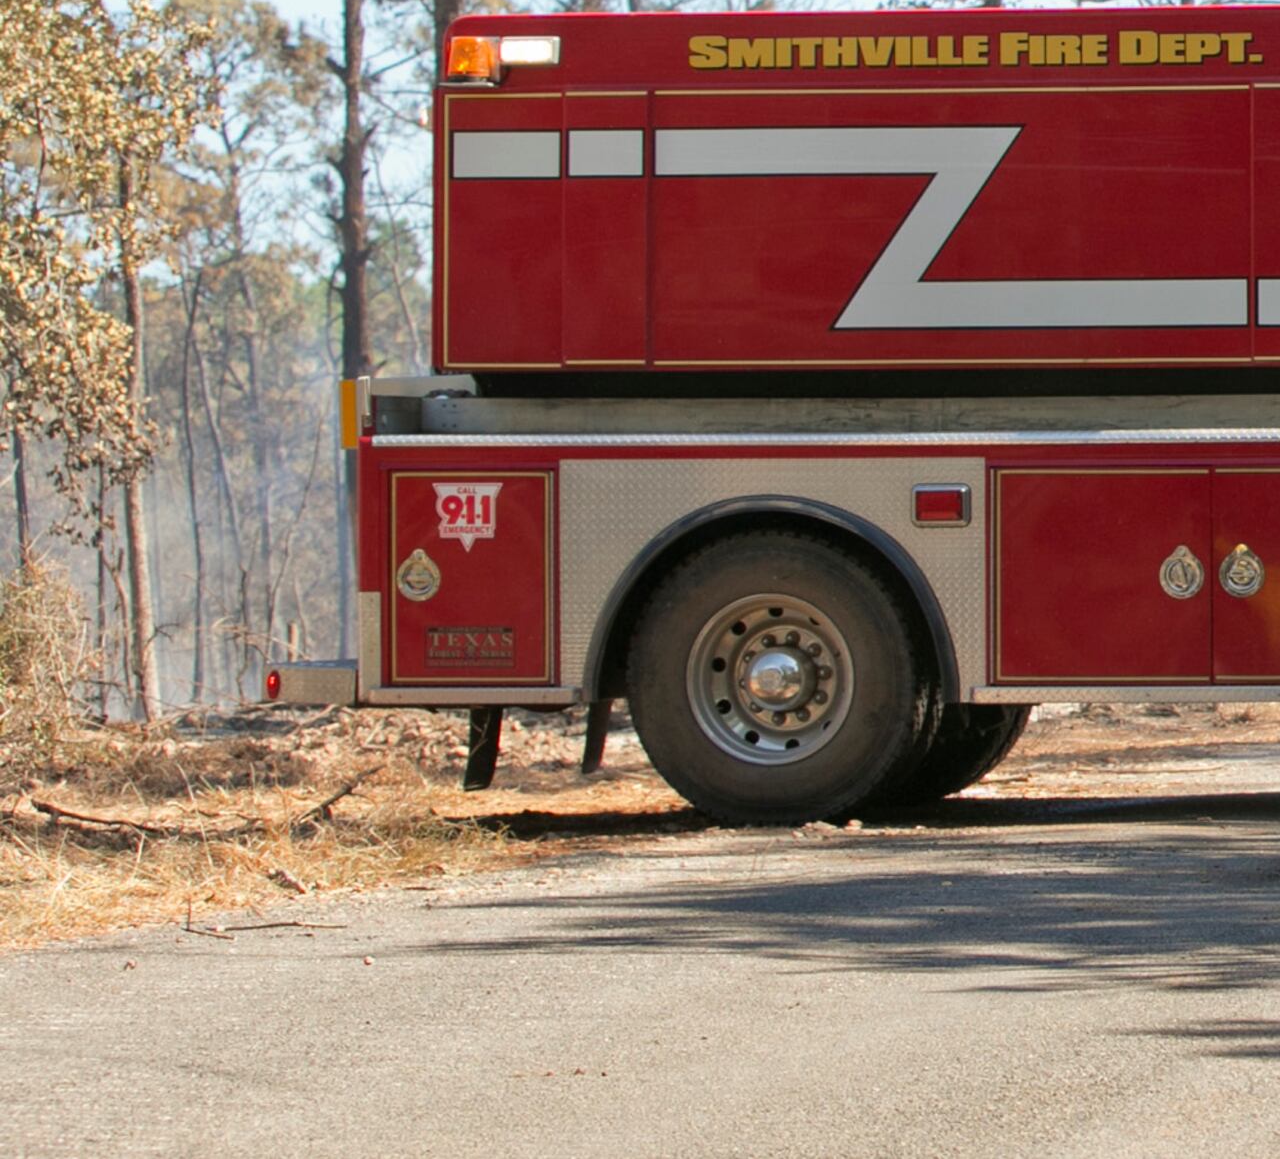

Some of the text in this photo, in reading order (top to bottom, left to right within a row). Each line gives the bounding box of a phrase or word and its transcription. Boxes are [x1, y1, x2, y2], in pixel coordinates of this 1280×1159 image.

[688, 30, 1263, 69] SMITHVILLE FIRE DEPT.
[428, 633, 513, 647] TEXAS
